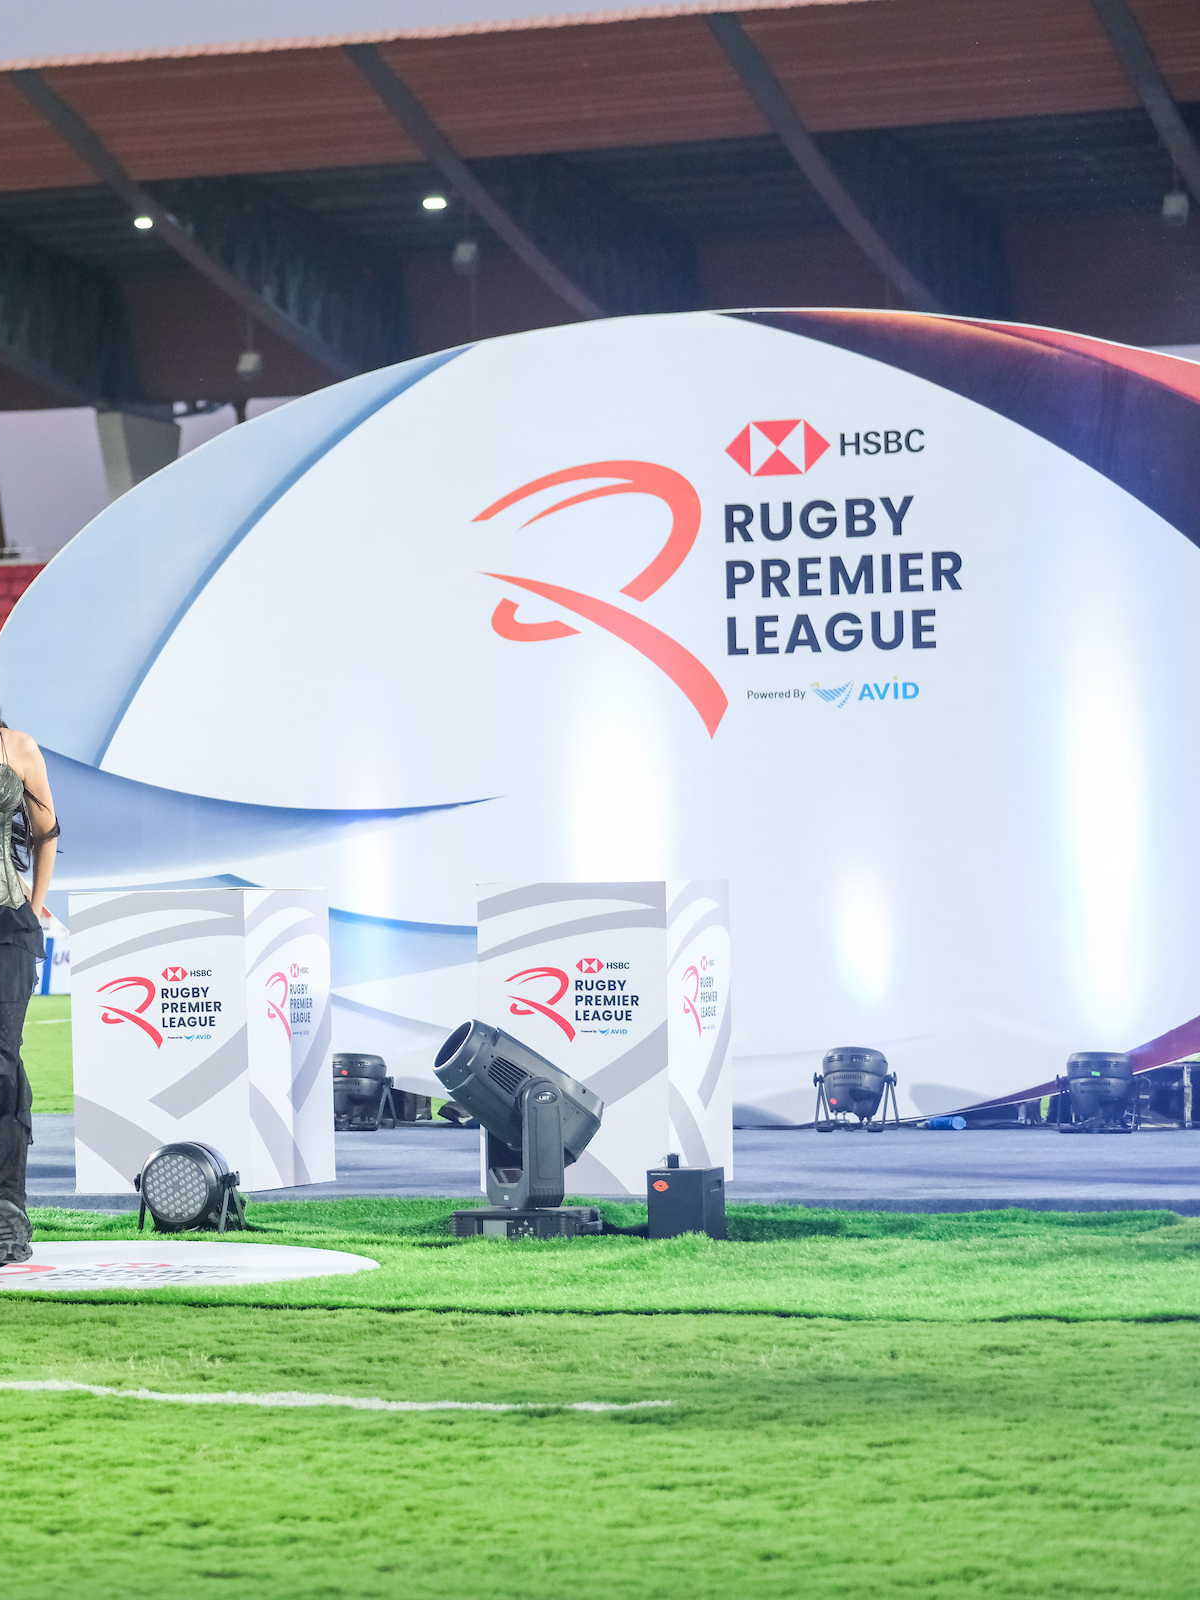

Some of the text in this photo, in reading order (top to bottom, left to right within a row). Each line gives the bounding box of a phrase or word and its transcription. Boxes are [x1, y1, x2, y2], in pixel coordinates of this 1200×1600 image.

[839, 428, 925, 456] HSBC
[724, 495, 915, 543] RUGBY
[725, 551, 963, 600] PREMIER
[726, 608, 937, 656] LEAGUE
[747, 689, 791, 700] Powered
[793, 689, 806, 701] By
[606, 962, 630, 970] HSBC
[190, 969, 212, 977] HSBC
[574, 979, 627, 991] RUGBY
[700, 976, 714, 988] RUGBY
[161, 987, 210, 999] RUGBY
[290, 983, 308, 995] RUGBY
[290, 997, 313, 1009] PREMIER
[575, 995, 639, 1006] PREMIER
[700, 991, 718, 1003] PREMIER
[161, 1001, 222, 1013] PREMIER
[700, 1006, 716, 1018] LEAGUE
[290, 1012, 311, 1023] LEAGUE
[575, 1010, 633, 1021] LEAGUE
[162, 1016, 216, 1028] LEAGUE
